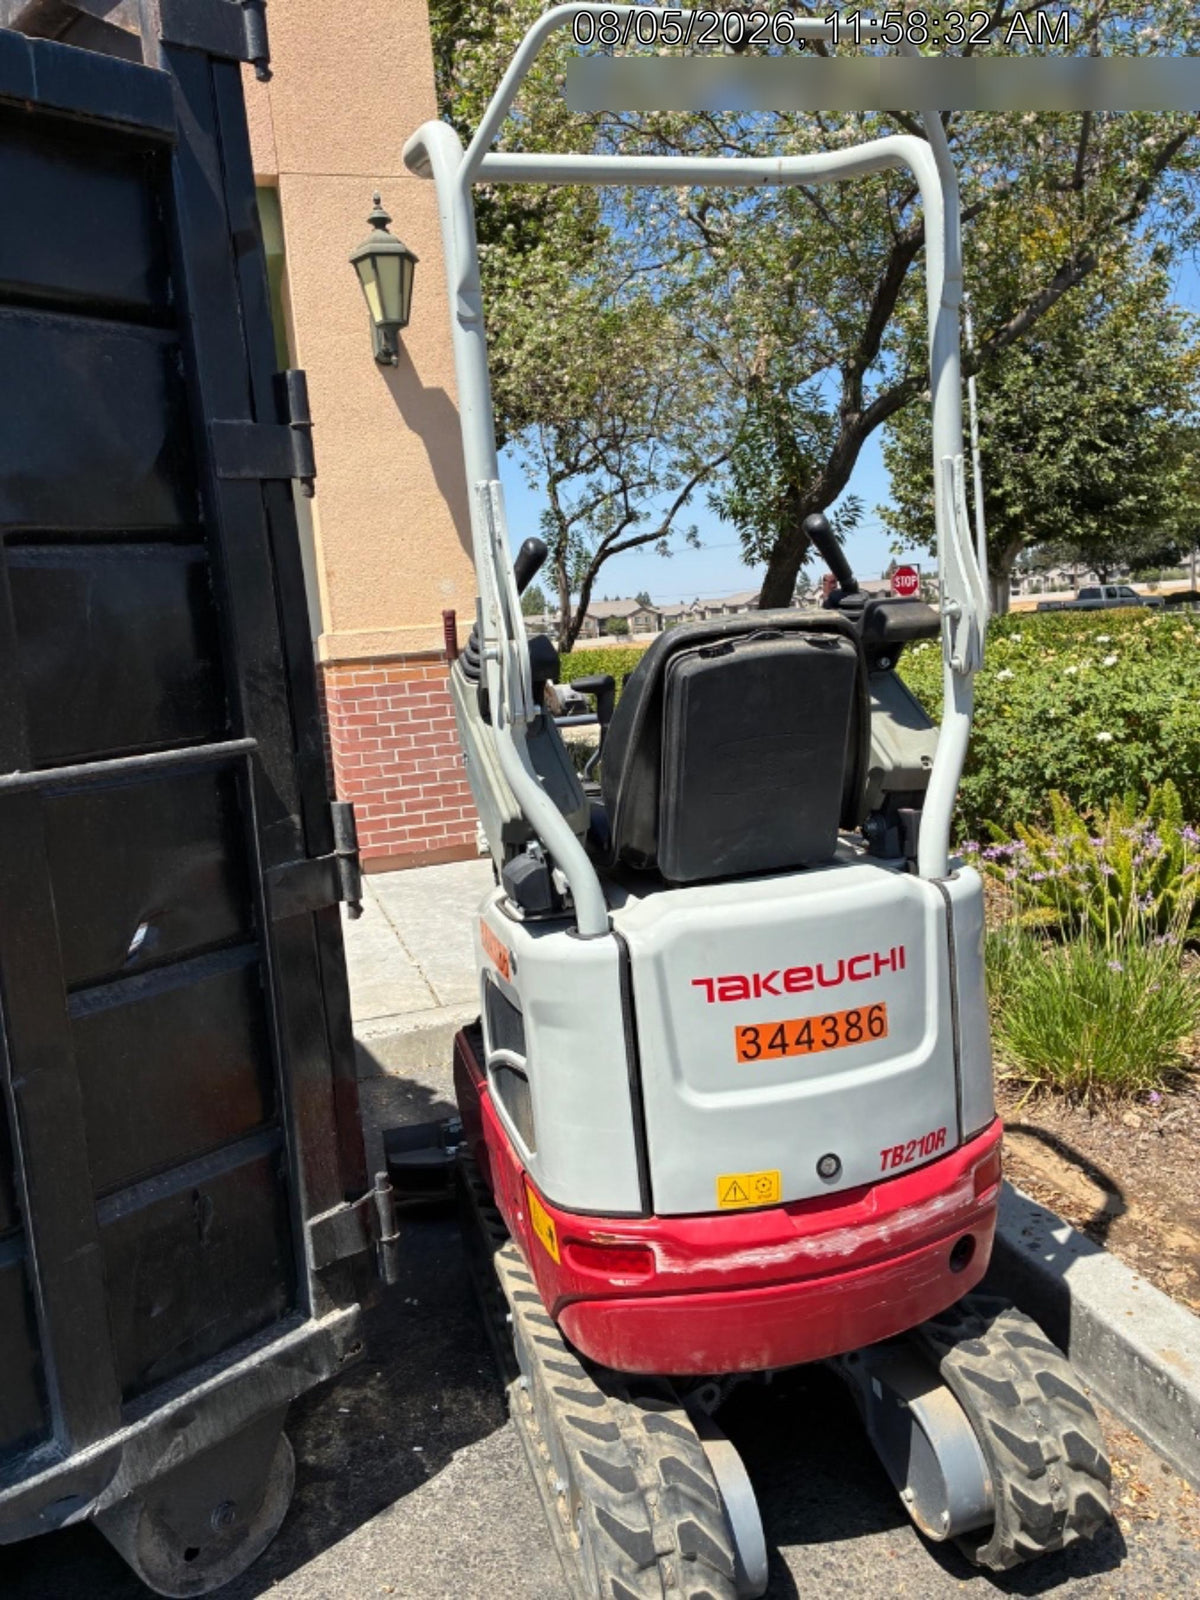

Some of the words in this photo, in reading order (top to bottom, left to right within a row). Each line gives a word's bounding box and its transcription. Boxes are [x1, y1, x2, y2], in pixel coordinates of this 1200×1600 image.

[895, 575, 917, 588] STOP
[741, 1005, 885, 1060] 344386
[879, 1126, 947, 1171] TB210R
